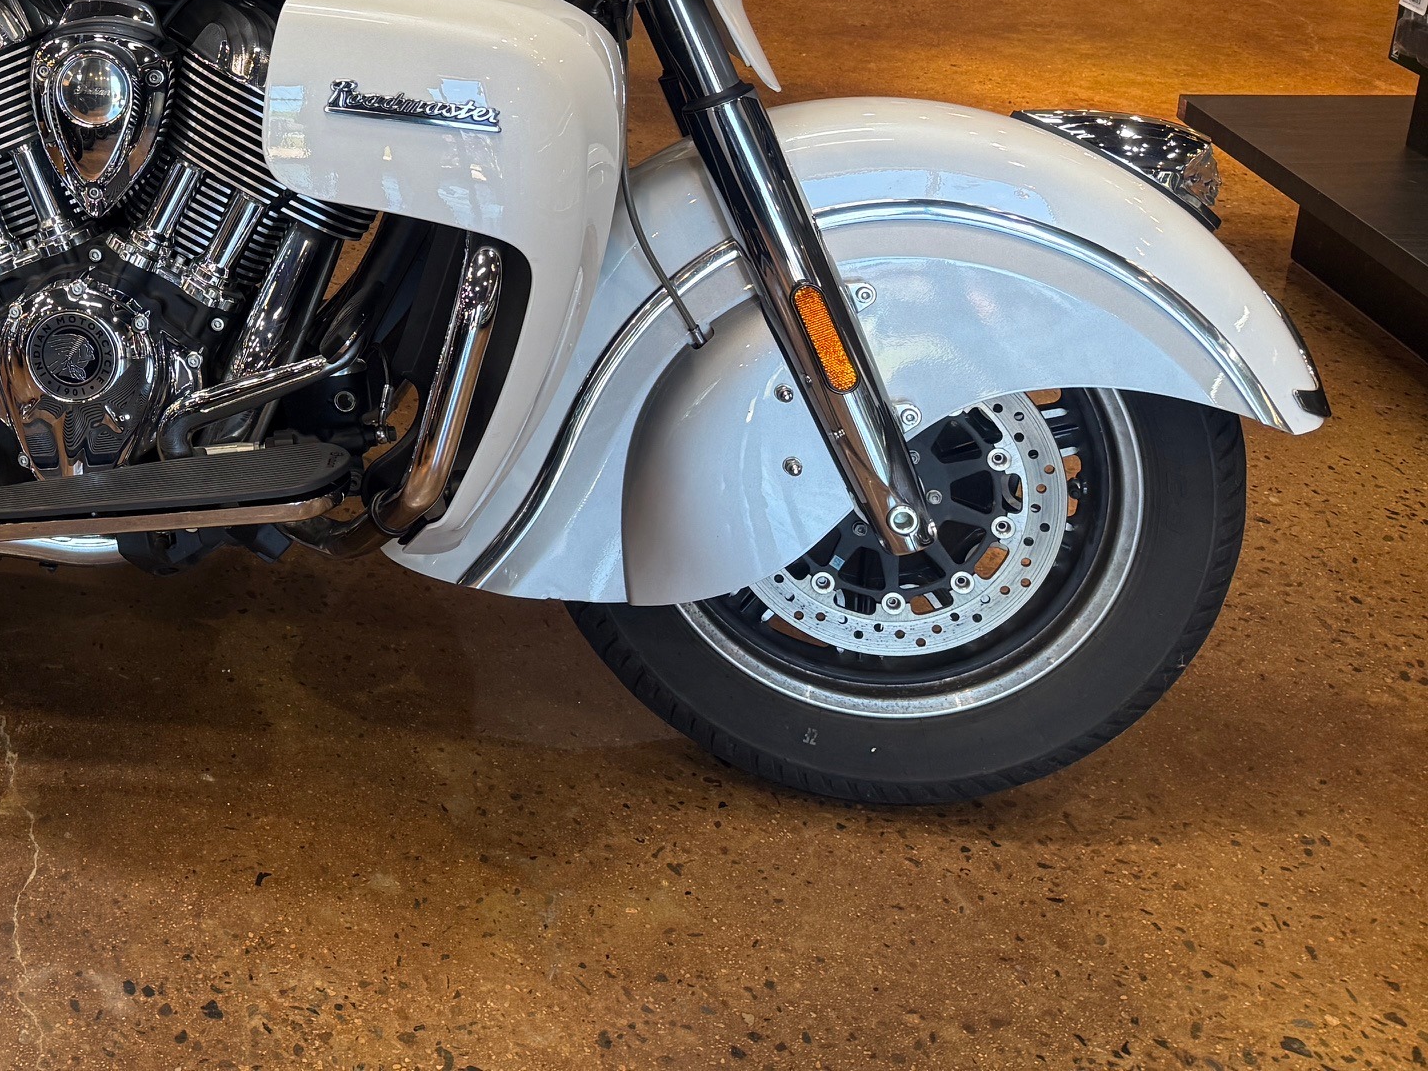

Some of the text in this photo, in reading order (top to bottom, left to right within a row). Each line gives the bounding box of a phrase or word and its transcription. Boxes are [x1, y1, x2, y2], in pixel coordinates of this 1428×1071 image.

[73, 84, 111, 96] Indian
[328, 79, 500, 125] Roadmaster
[32, 316, 113, 385] INDIAN MOTORCYCLE
[57, 385, 86, 397] 1901
